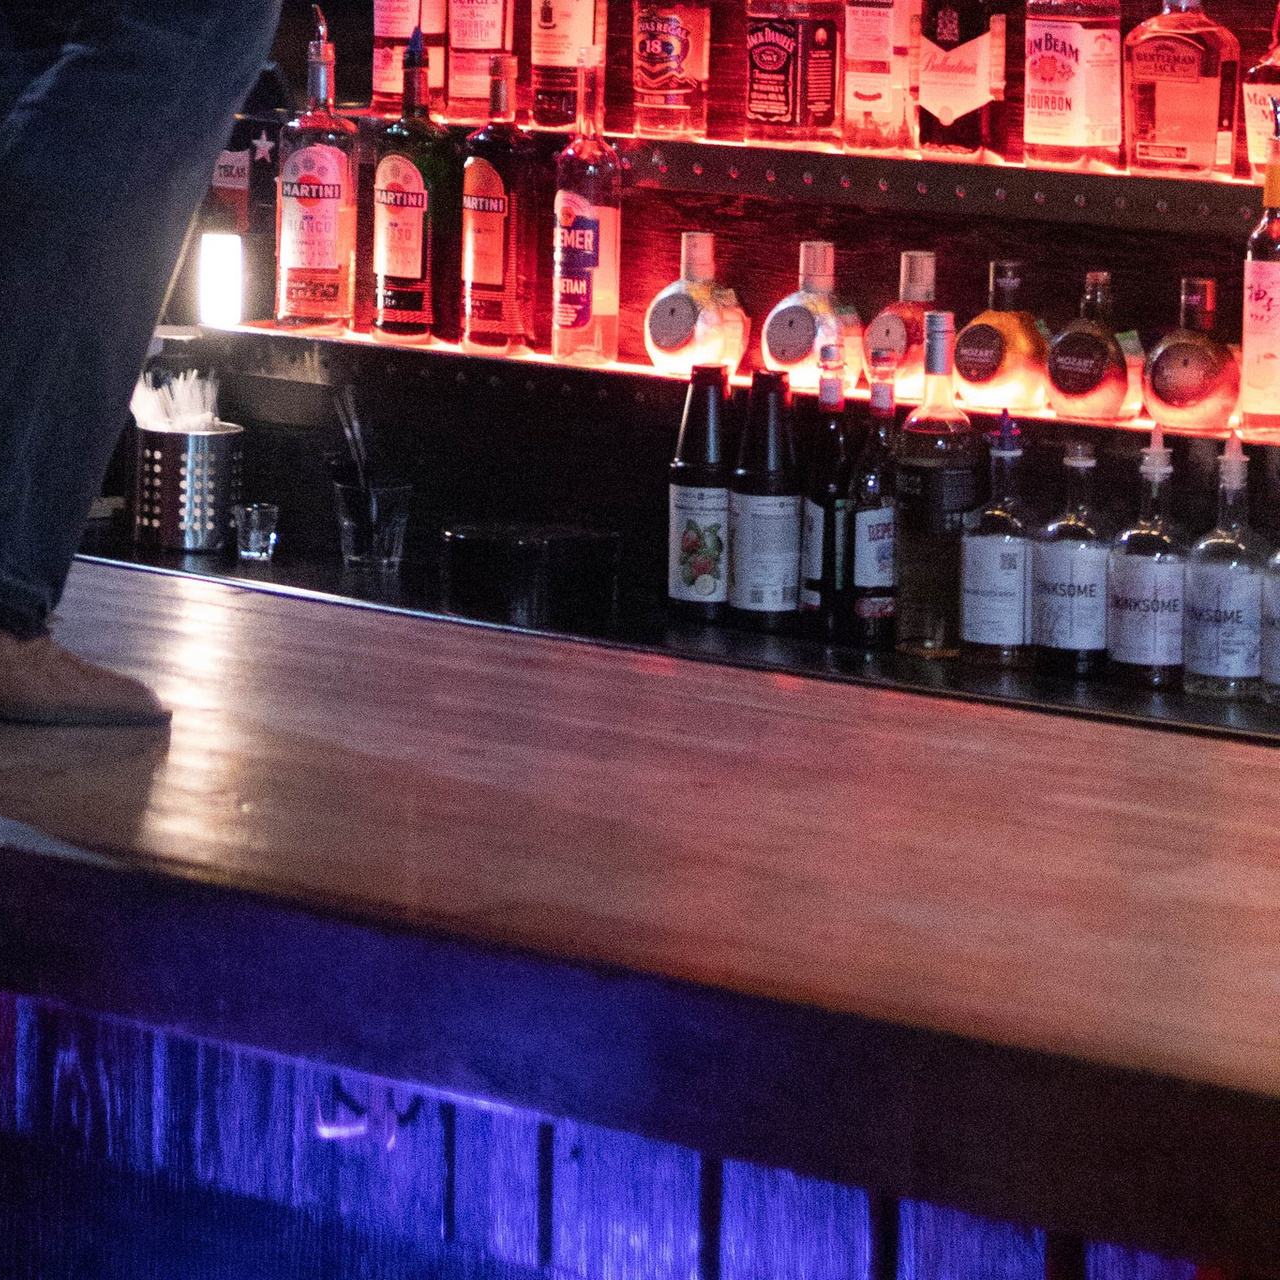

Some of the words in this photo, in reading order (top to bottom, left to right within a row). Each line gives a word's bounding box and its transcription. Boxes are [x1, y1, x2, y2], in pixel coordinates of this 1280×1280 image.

[645, 39, 663, 54] 18
[1044, 32, 1080, 63] BEAM
[282, 183, 340, 198] MARTINI
